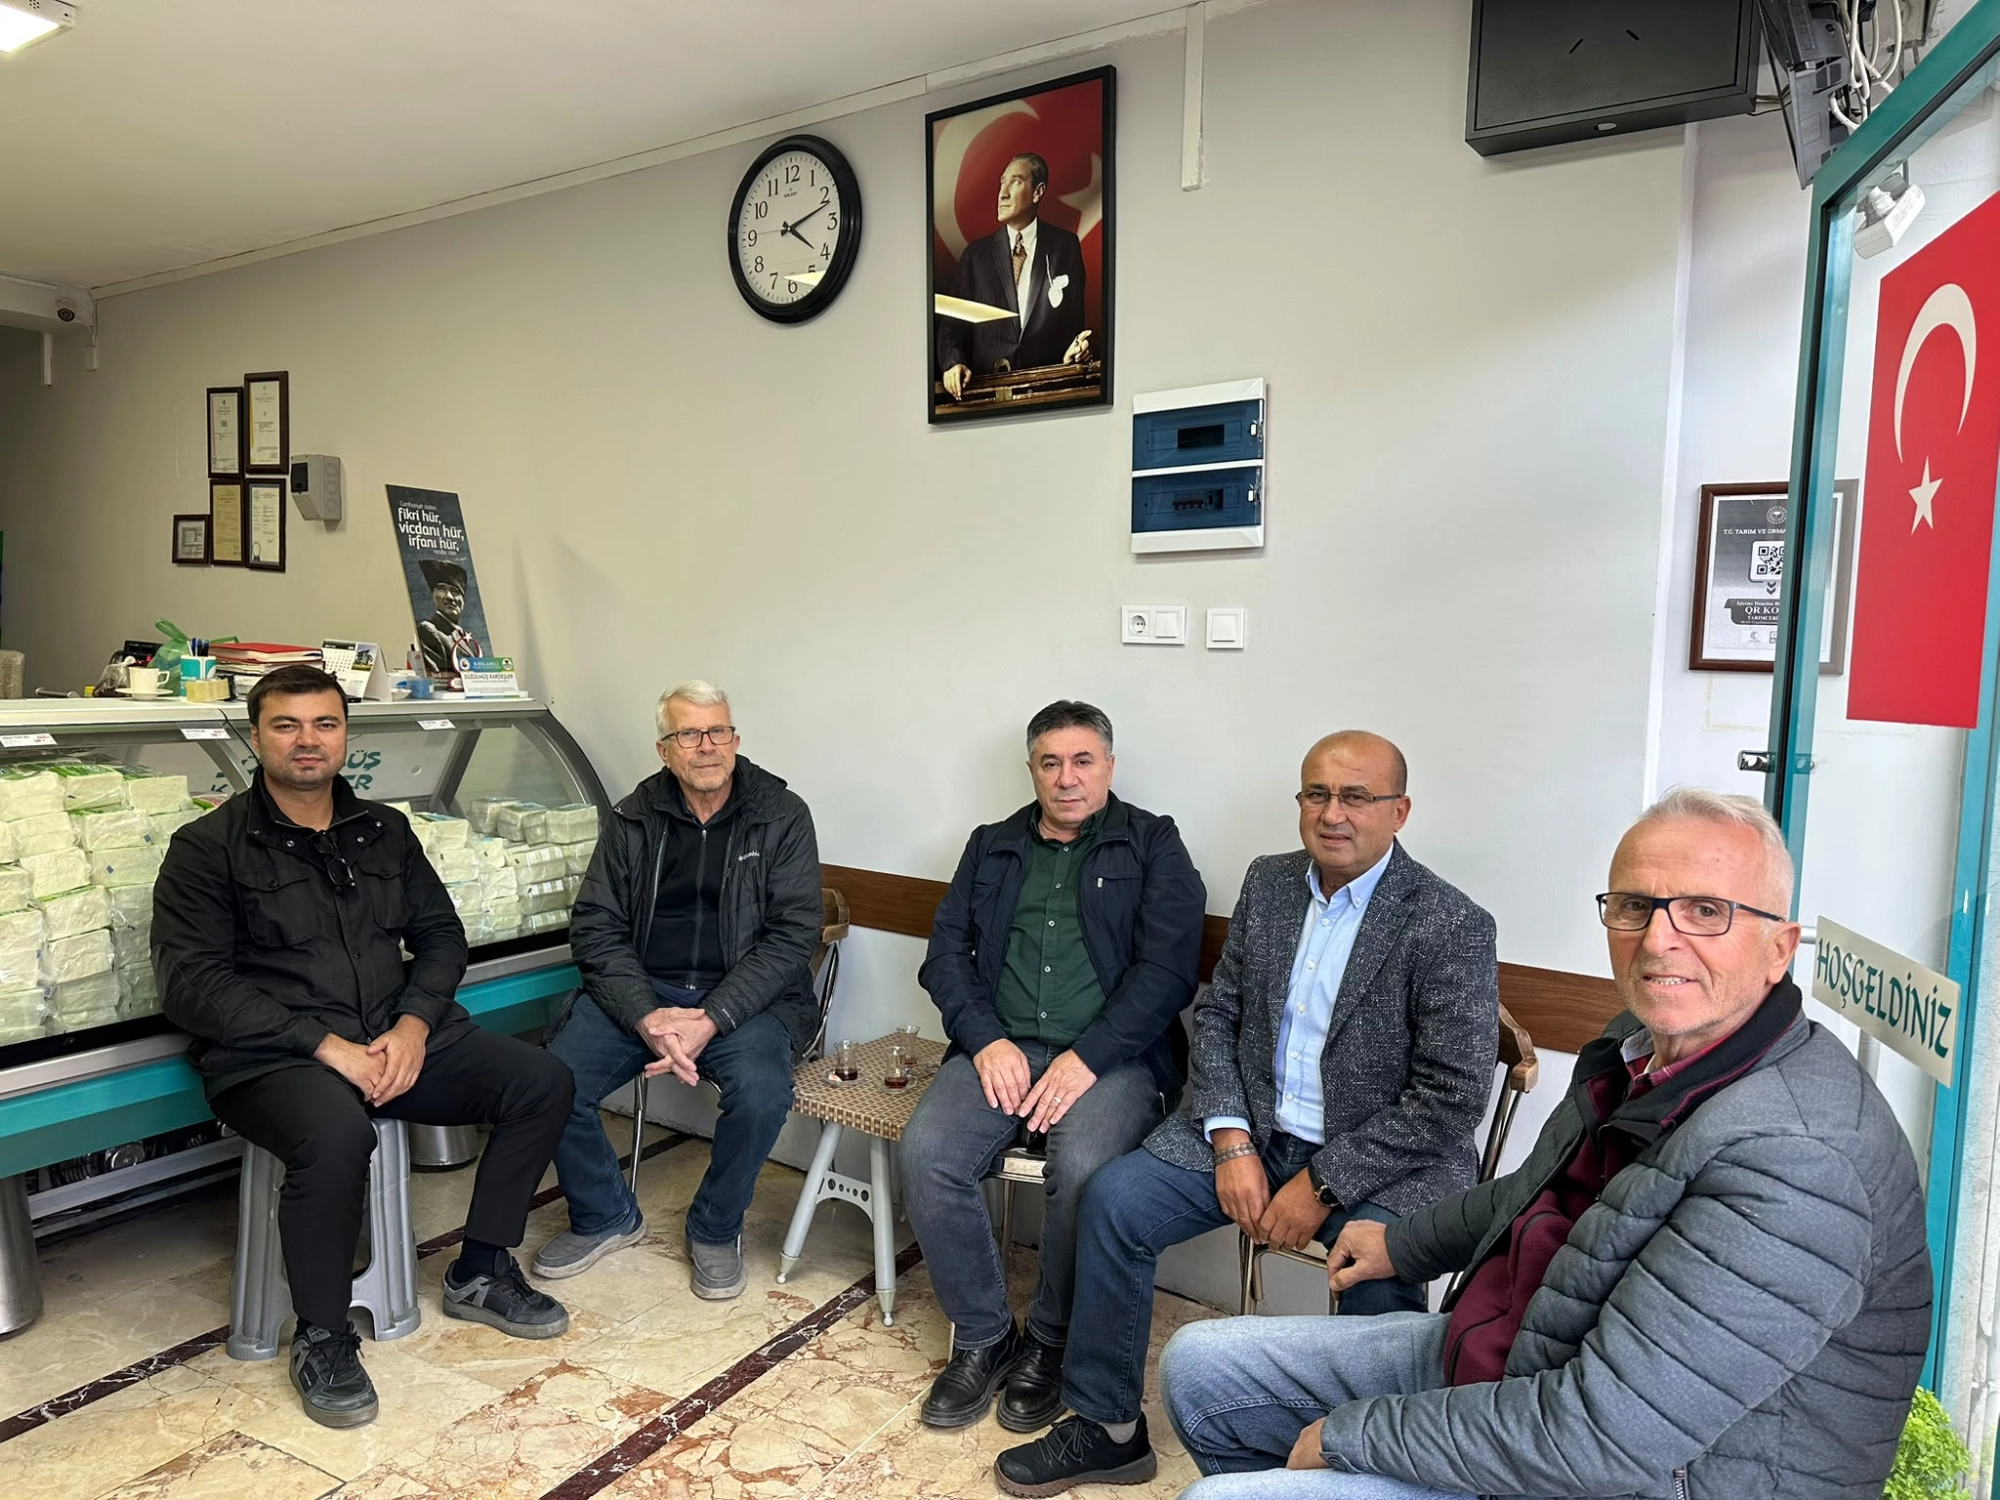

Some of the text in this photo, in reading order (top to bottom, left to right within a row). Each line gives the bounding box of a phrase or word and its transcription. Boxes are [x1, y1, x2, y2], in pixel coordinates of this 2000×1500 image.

[785, 165, 800, 184] 12
[810, 170, 815, 187] 1
[767, 178, 779, 197] 11
[819, 186, 831, 204] 2
[755, 201, 768, 220] 10
[827, 212, 838, 231] 3
[747, 230, 757, 247] 9
[820, 242, 831, 261] 4
[754, 256, 764, 273] 8
[769, 272, 779, 290] 7
[787, 278, 798, 295] 6
[398, 507, 442, 525] fikri hür,
[398, 521, 464, 541] vicdanı hür,
[408, 534, 459, 552] irfanı hür,
[1744, 606, 1780, 615] QR KO
[1816, 937, 1952, 1059] HOŞGELDİNİZ
